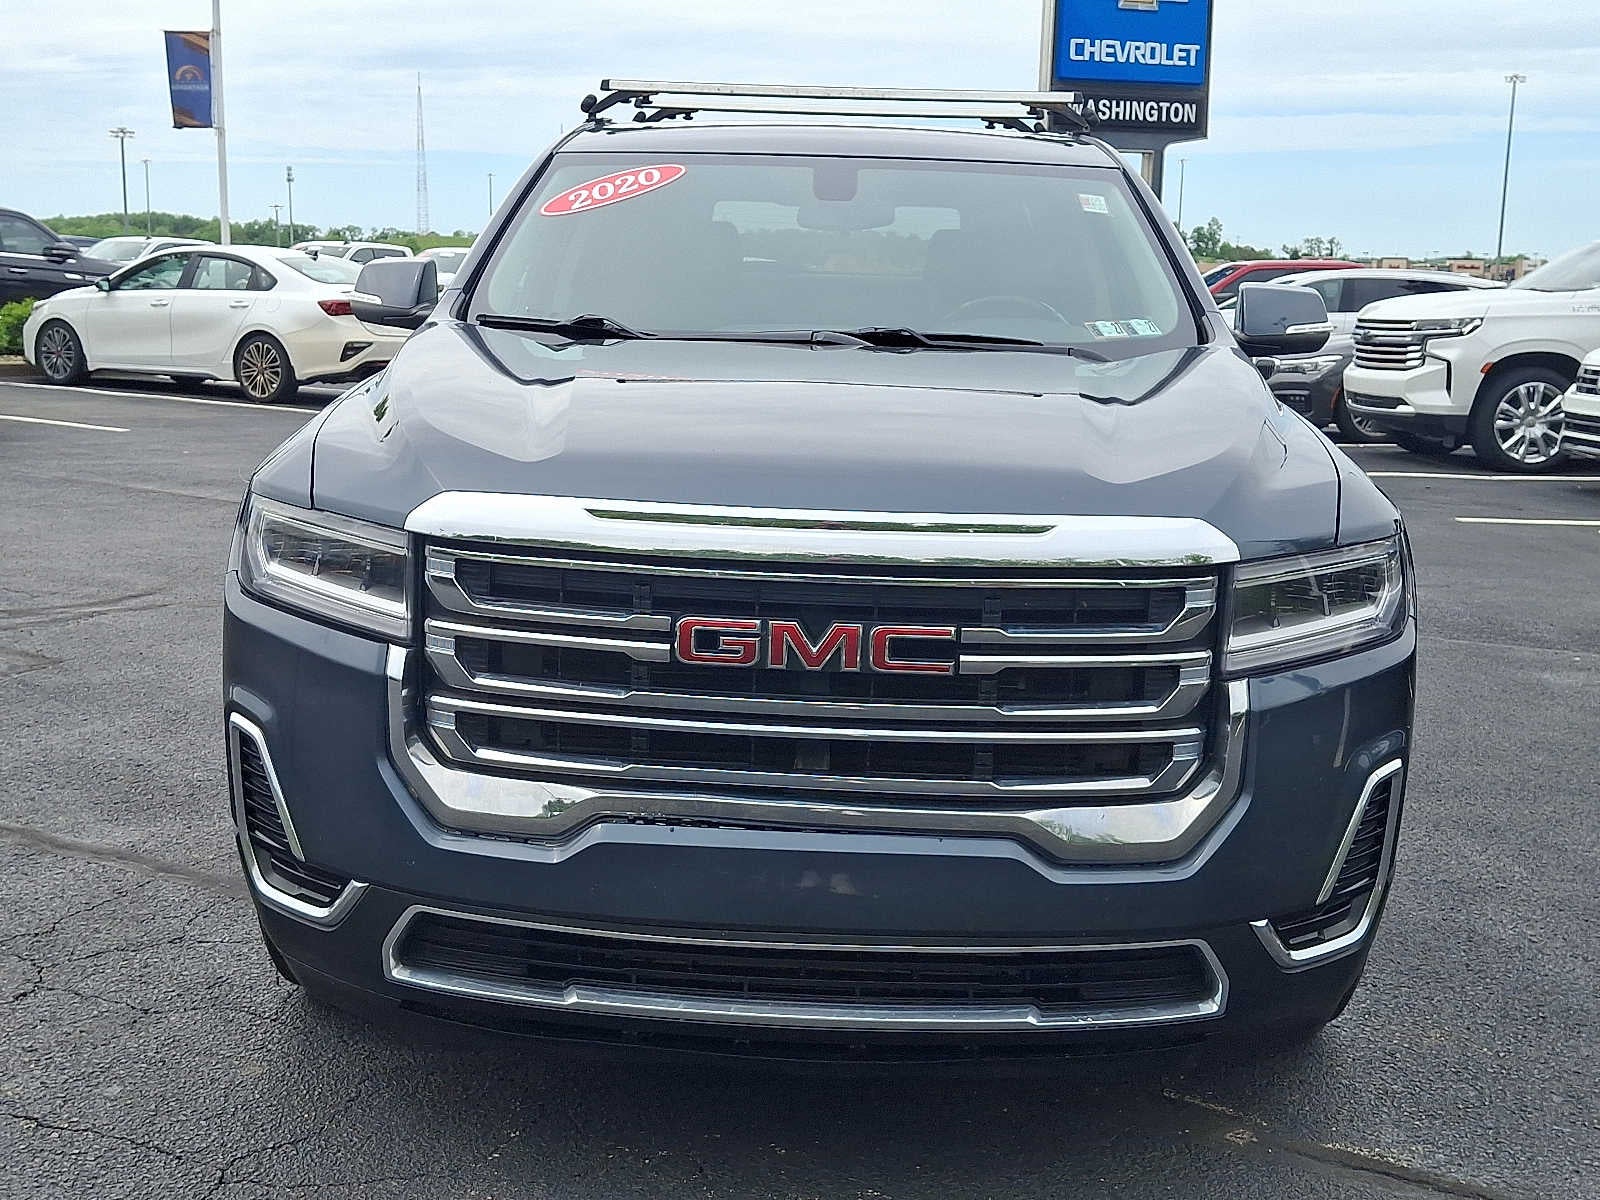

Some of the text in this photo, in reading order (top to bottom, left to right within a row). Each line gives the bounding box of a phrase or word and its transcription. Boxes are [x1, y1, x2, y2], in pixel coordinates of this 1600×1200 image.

[1069, 38, 1201, 67] CHEVROLET
[568, 168, 661, 210] 2020
[675, 616, 957, 676] GMC
